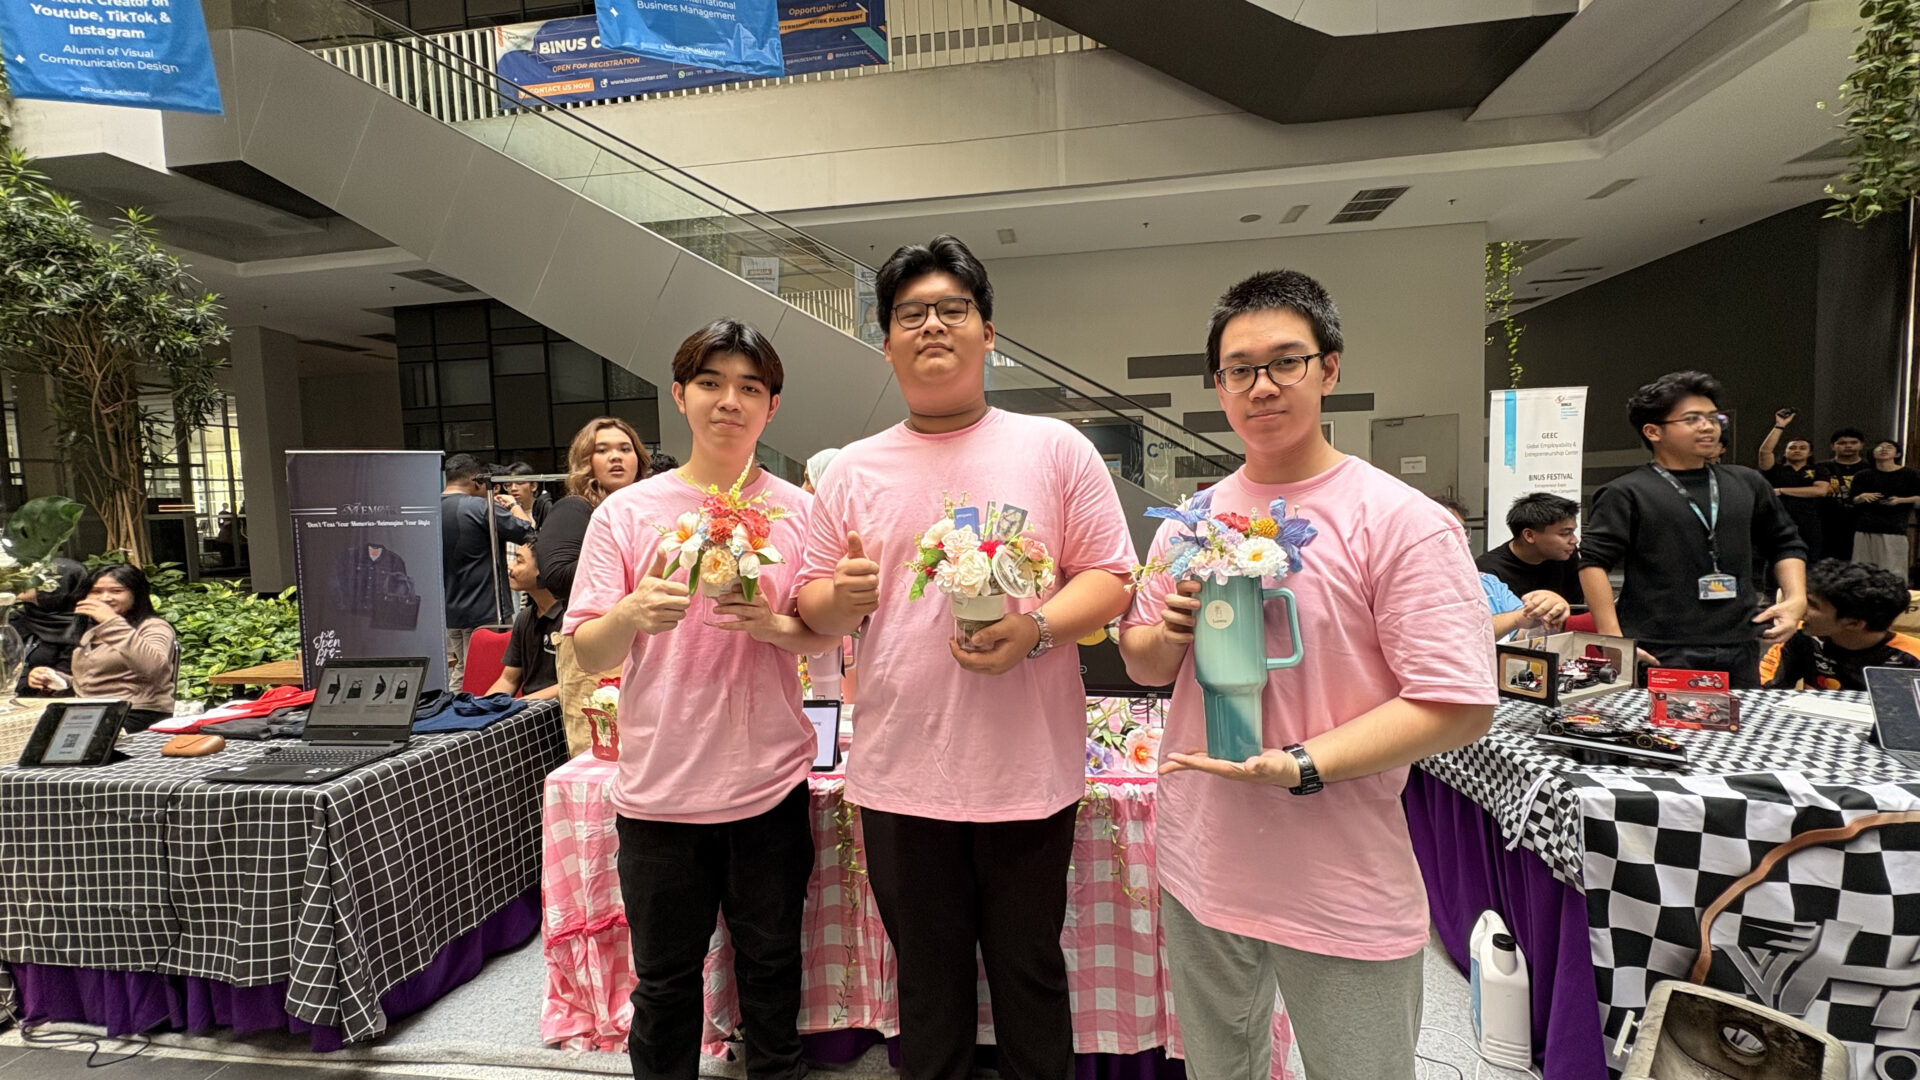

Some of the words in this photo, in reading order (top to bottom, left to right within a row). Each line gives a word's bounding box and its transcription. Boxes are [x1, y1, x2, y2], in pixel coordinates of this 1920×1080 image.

[30, 4, 104, 22] Youtube,
[106, 10, 158, 24] TikTok,
[160, 12, 172, 23] &
[637, 0, 679, 12] Business
[680, 5, 736, 21] Management
[69, 24, 146, 40] Instagram
[62, 44, 105, 56] Alumni
[107, 47, 119, 56] of
[120, 48, 154, 58] Visual
[539, 37, 587, 54] BINUS
[39, 53, 135, 69] Communication
[137, 62, 179, 73] Design
[552, 64, 571, 73] OPEN
[572, 62, 588, 70] FOR
[588, 56, 640, 69] REGISTRATION
[1546, 472, 1574, 481] FESTIVAL
